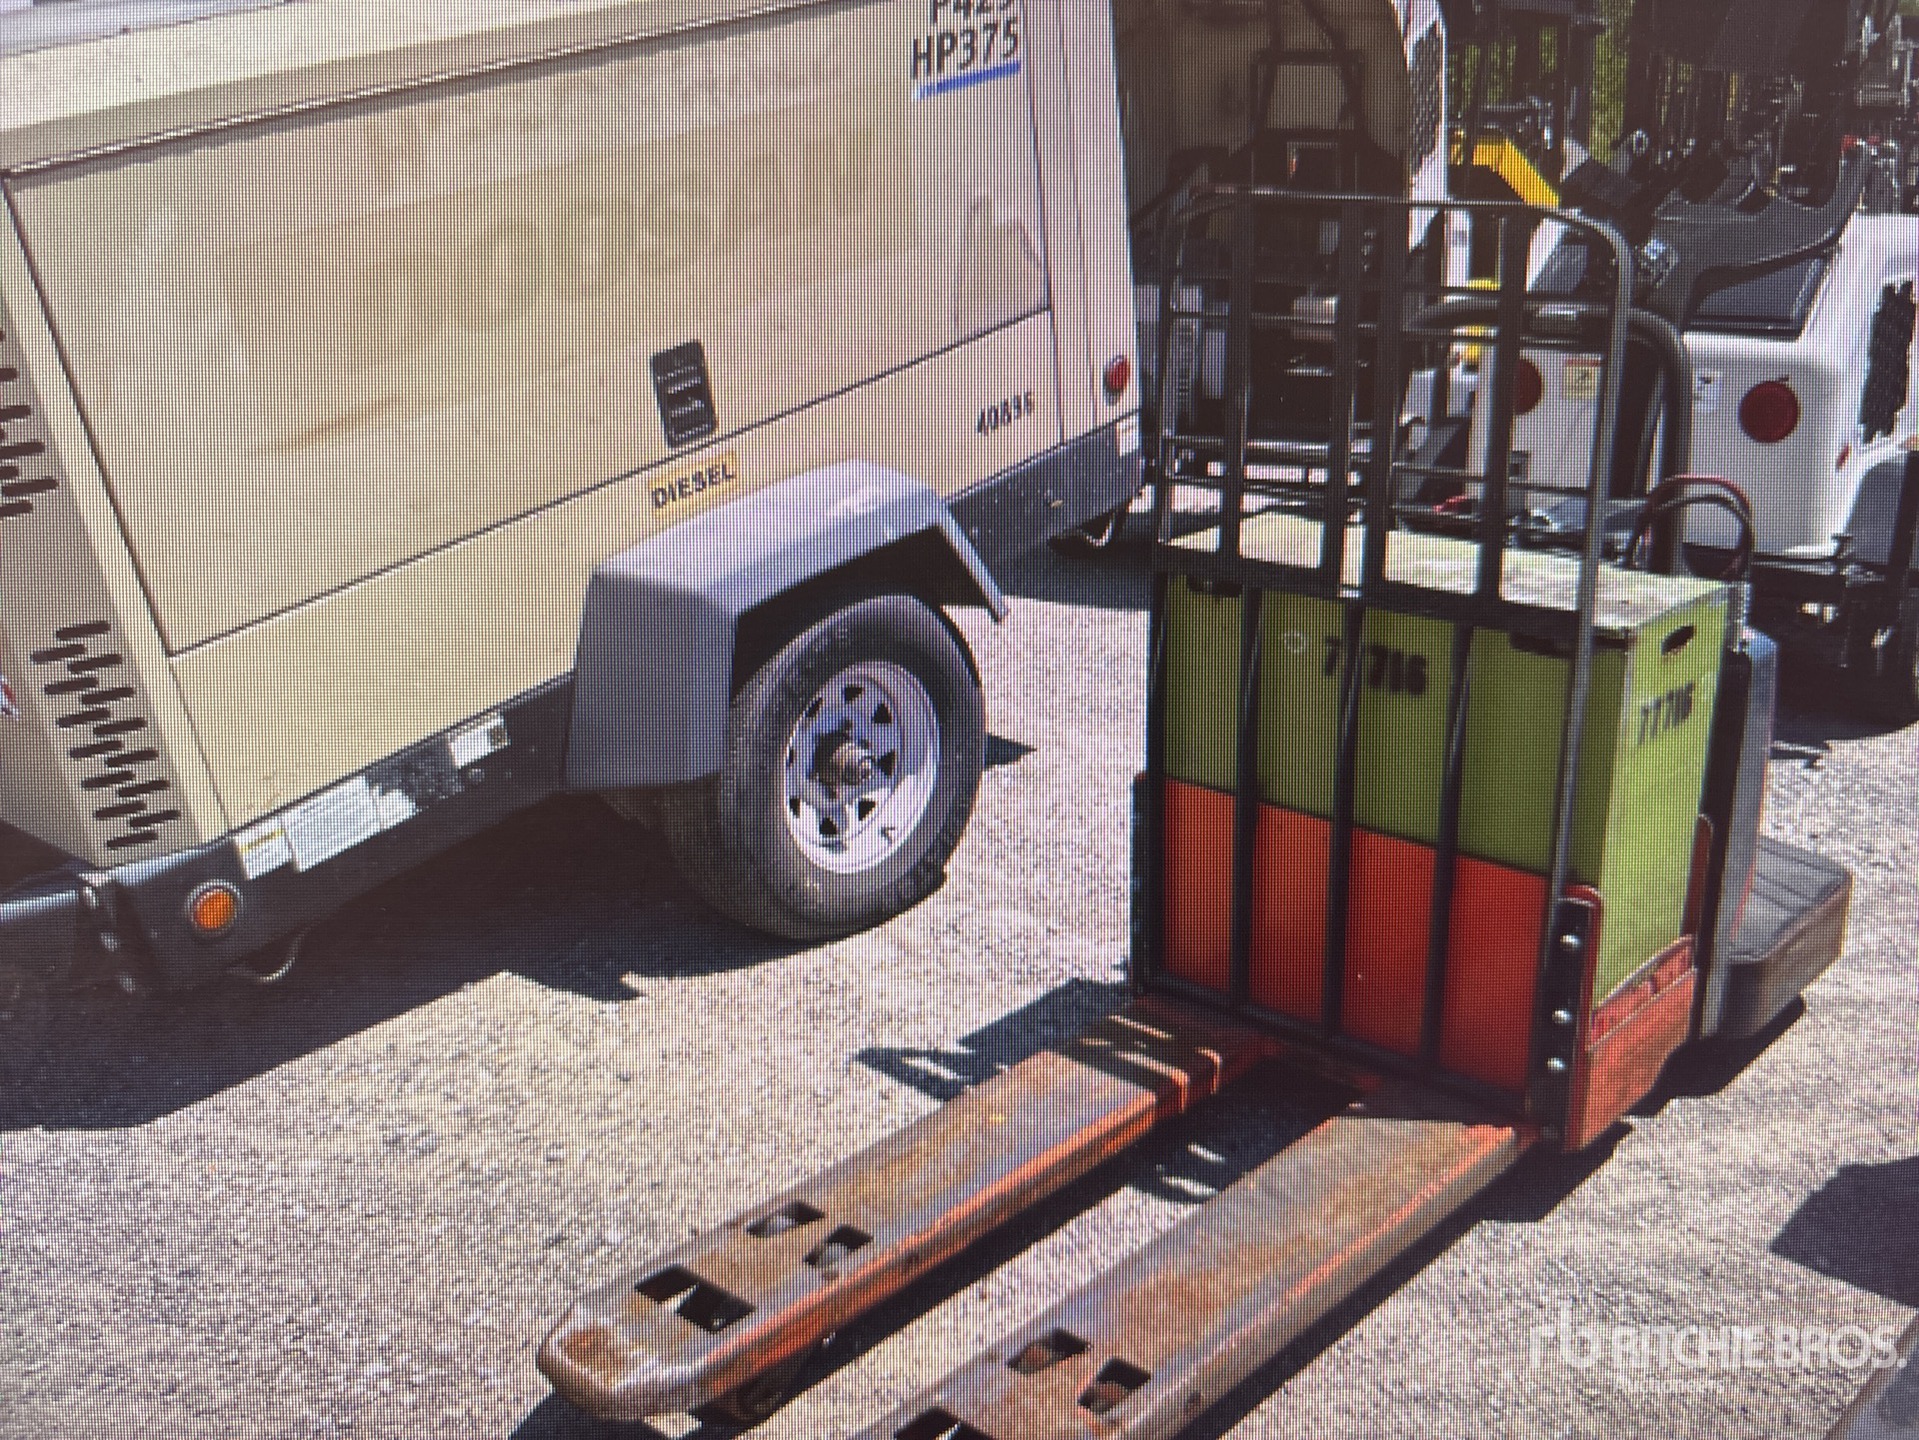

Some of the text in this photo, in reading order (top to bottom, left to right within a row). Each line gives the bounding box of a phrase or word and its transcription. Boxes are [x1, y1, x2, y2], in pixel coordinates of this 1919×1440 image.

[911, 16, 1019, 79] HP375
[347, 126, 875, 374] DOOSAN
[652, 462, 736, 508] DIESEL
[1324, 635, 1428, 696] 7716
